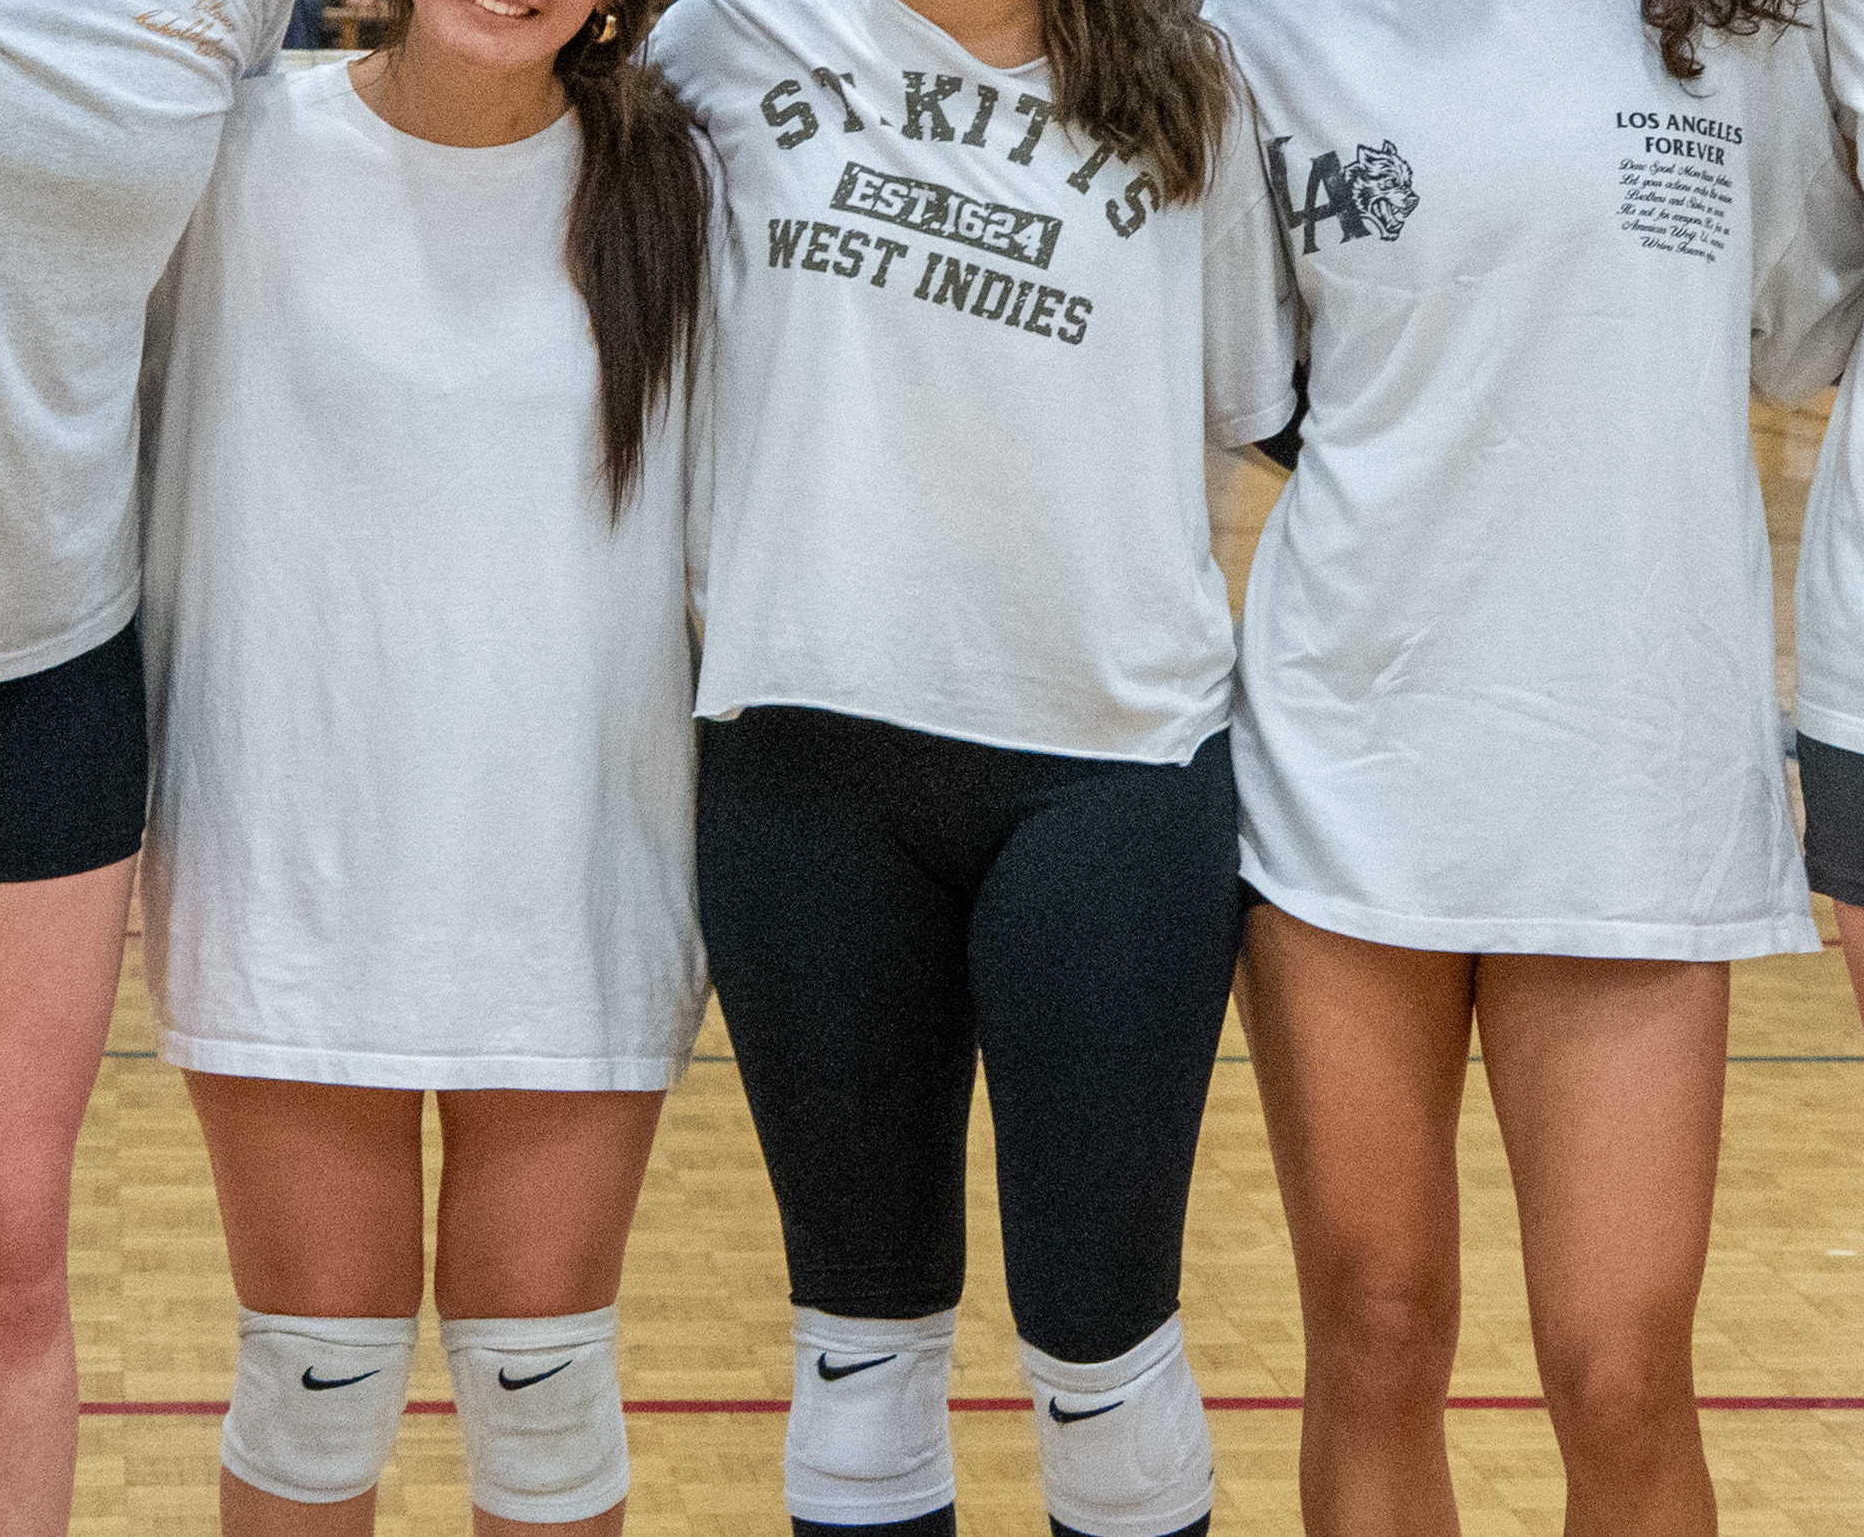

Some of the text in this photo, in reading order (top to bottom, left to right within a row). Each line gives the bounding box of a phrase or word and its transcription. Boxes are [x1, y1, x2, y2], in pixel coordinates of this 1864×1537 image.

[1616, 112, 1743, 145] LOS ANGELES
[1645, 136, 1725, 166] FOREVER
[767, 218, 1094, 346] WEST INDIES
